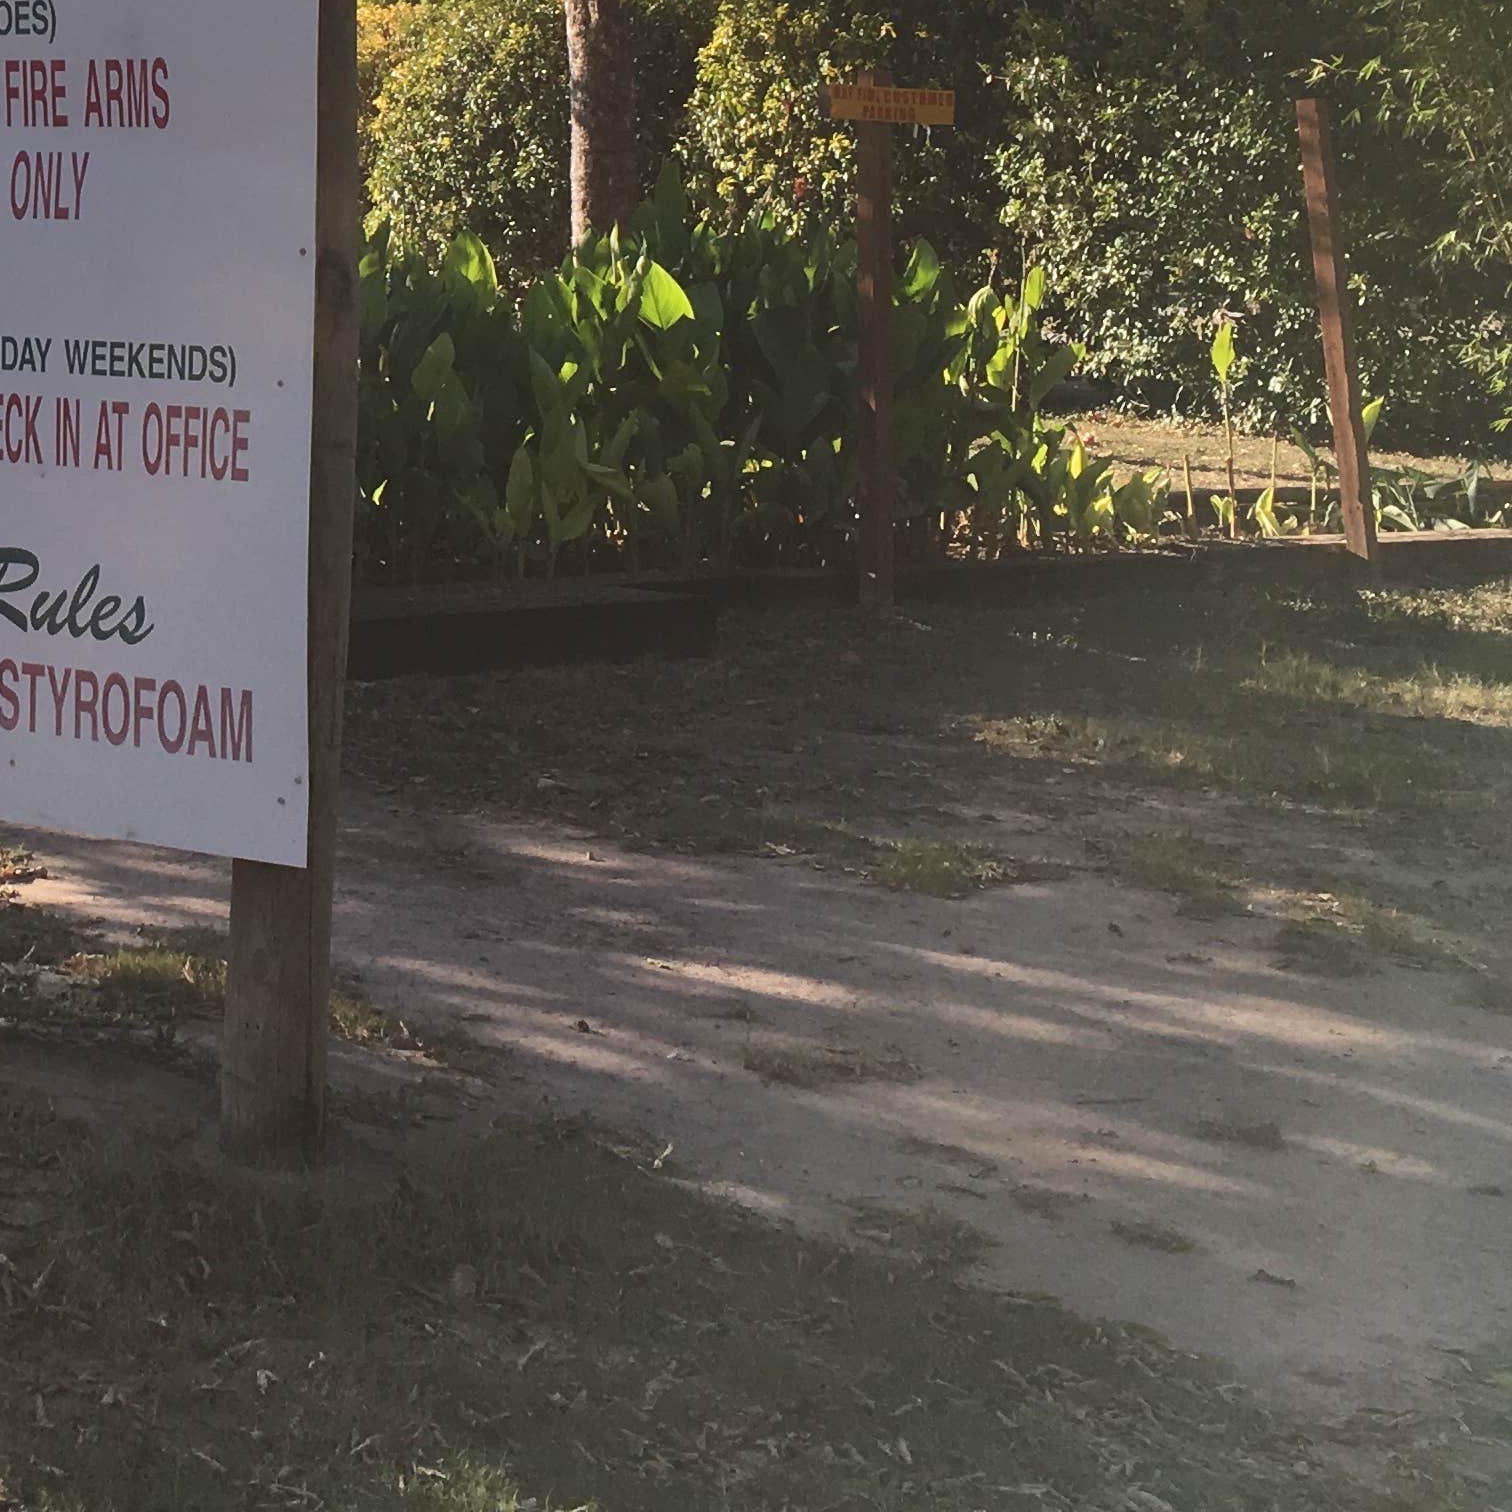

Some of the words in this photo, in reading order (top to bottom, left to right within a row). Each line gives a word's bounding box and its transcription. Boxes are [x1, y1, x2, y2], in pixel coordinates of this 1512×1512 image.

[5, 60, 69, 127] FIRE
[84, 57, 169, 129] ARMS
[11, 150, 90, 220] ONLY
[64, 339, 236, 388] WEEKENDS)
[56, 397, 80, 468] IN
[93, 400, 129, 471] AT
[142, 402, 250, 482] OFFICE
